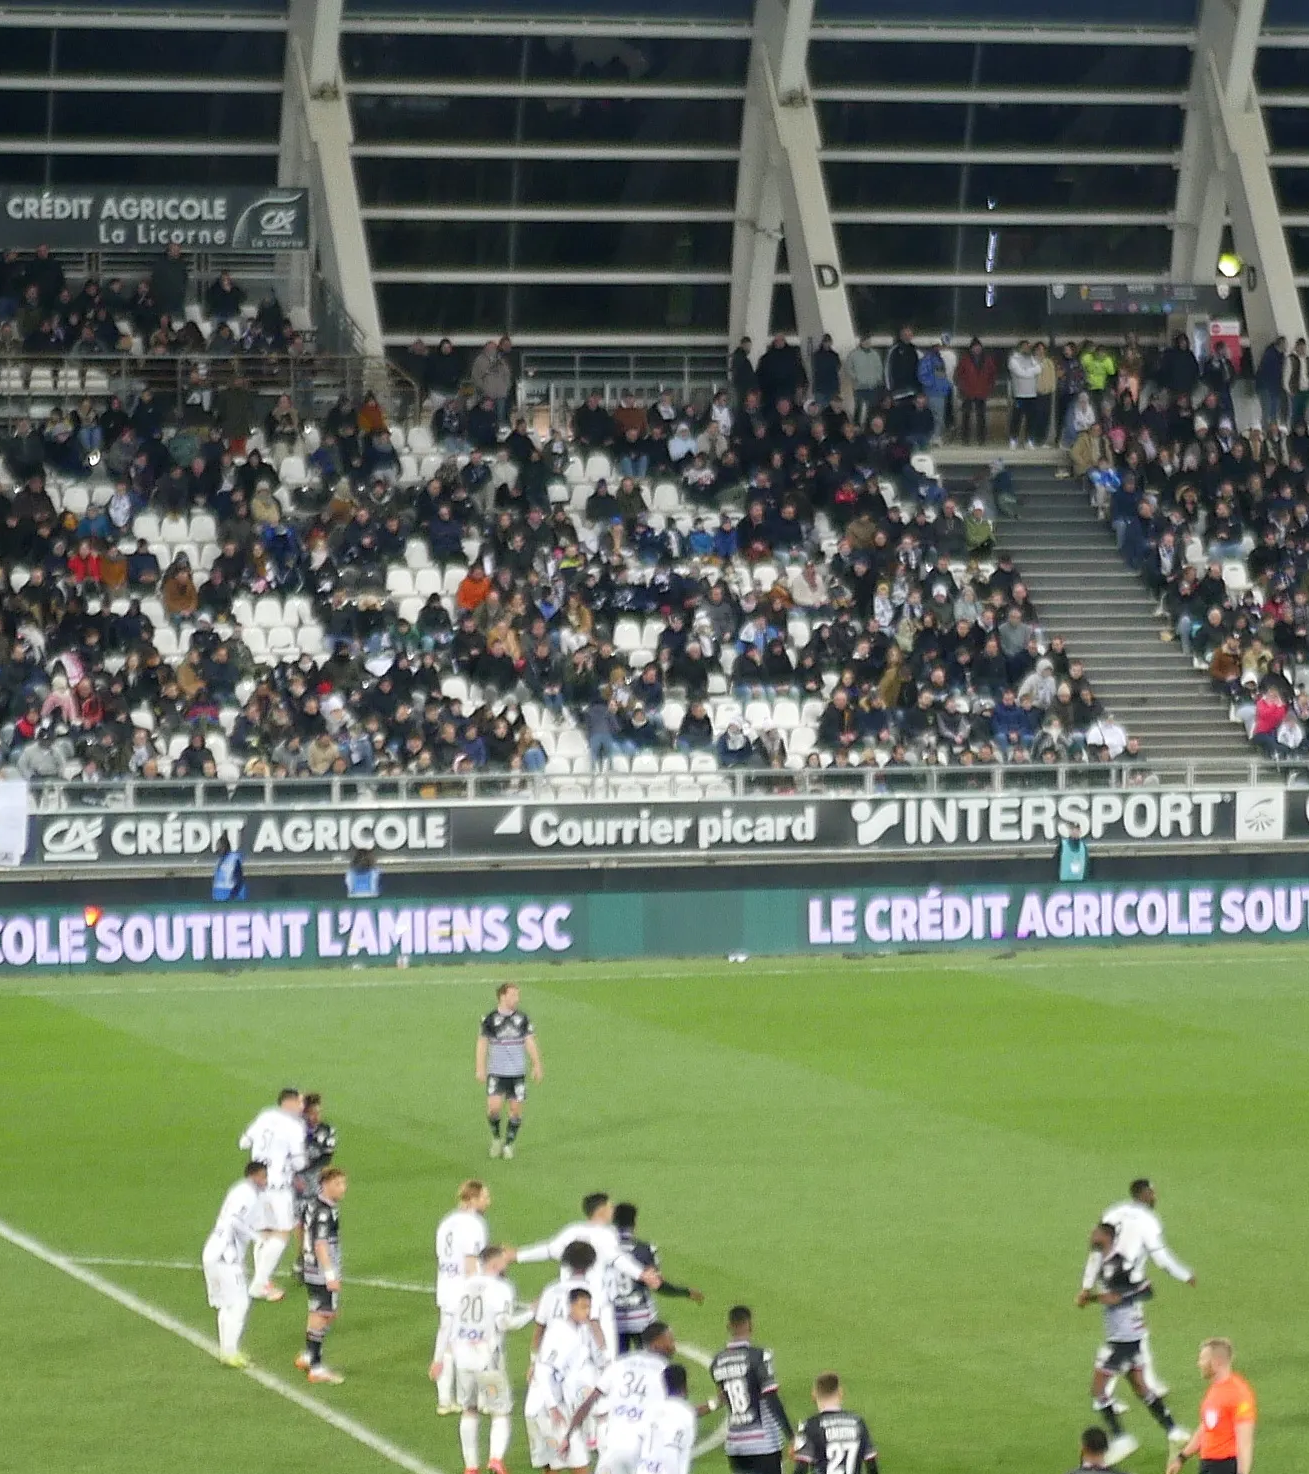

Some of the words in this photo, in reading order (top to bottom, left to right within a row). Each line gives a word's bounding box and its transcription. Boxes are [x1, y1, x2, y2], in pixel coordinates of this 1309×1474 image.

[6, 192, 91, 221] CRÉDIT
[100, 198, 226, 221] AGRICOLE
[99, 222, 125, 244] La
[137, 222, 227, 246] Licorne
[813, 263, 839, 290] D
[111, 812, 245, 855] CRÉDIT
[253, 814, 447, 853] AGRICOLE
[530, 811, 692, 848] Courrier
[698, 807, 816, 848] picard
[905, 793, 1222, 844] INTERSPORT
[95, 908, 312, 964] SOUTIENT
[317, 903, 510, 959] L'AMIENS
[516, 903, 573, 953] SC
[808, 894, 856, 944] LE
[864, 886, 1009, 943] CRÉDIT
[1016, 886, 1212, 940] AGRICOLE
[460, 1293, 484, 1324] 20
[619, 1370, 647, 1402] 34
[723, 1378, 751, 1415] 18
